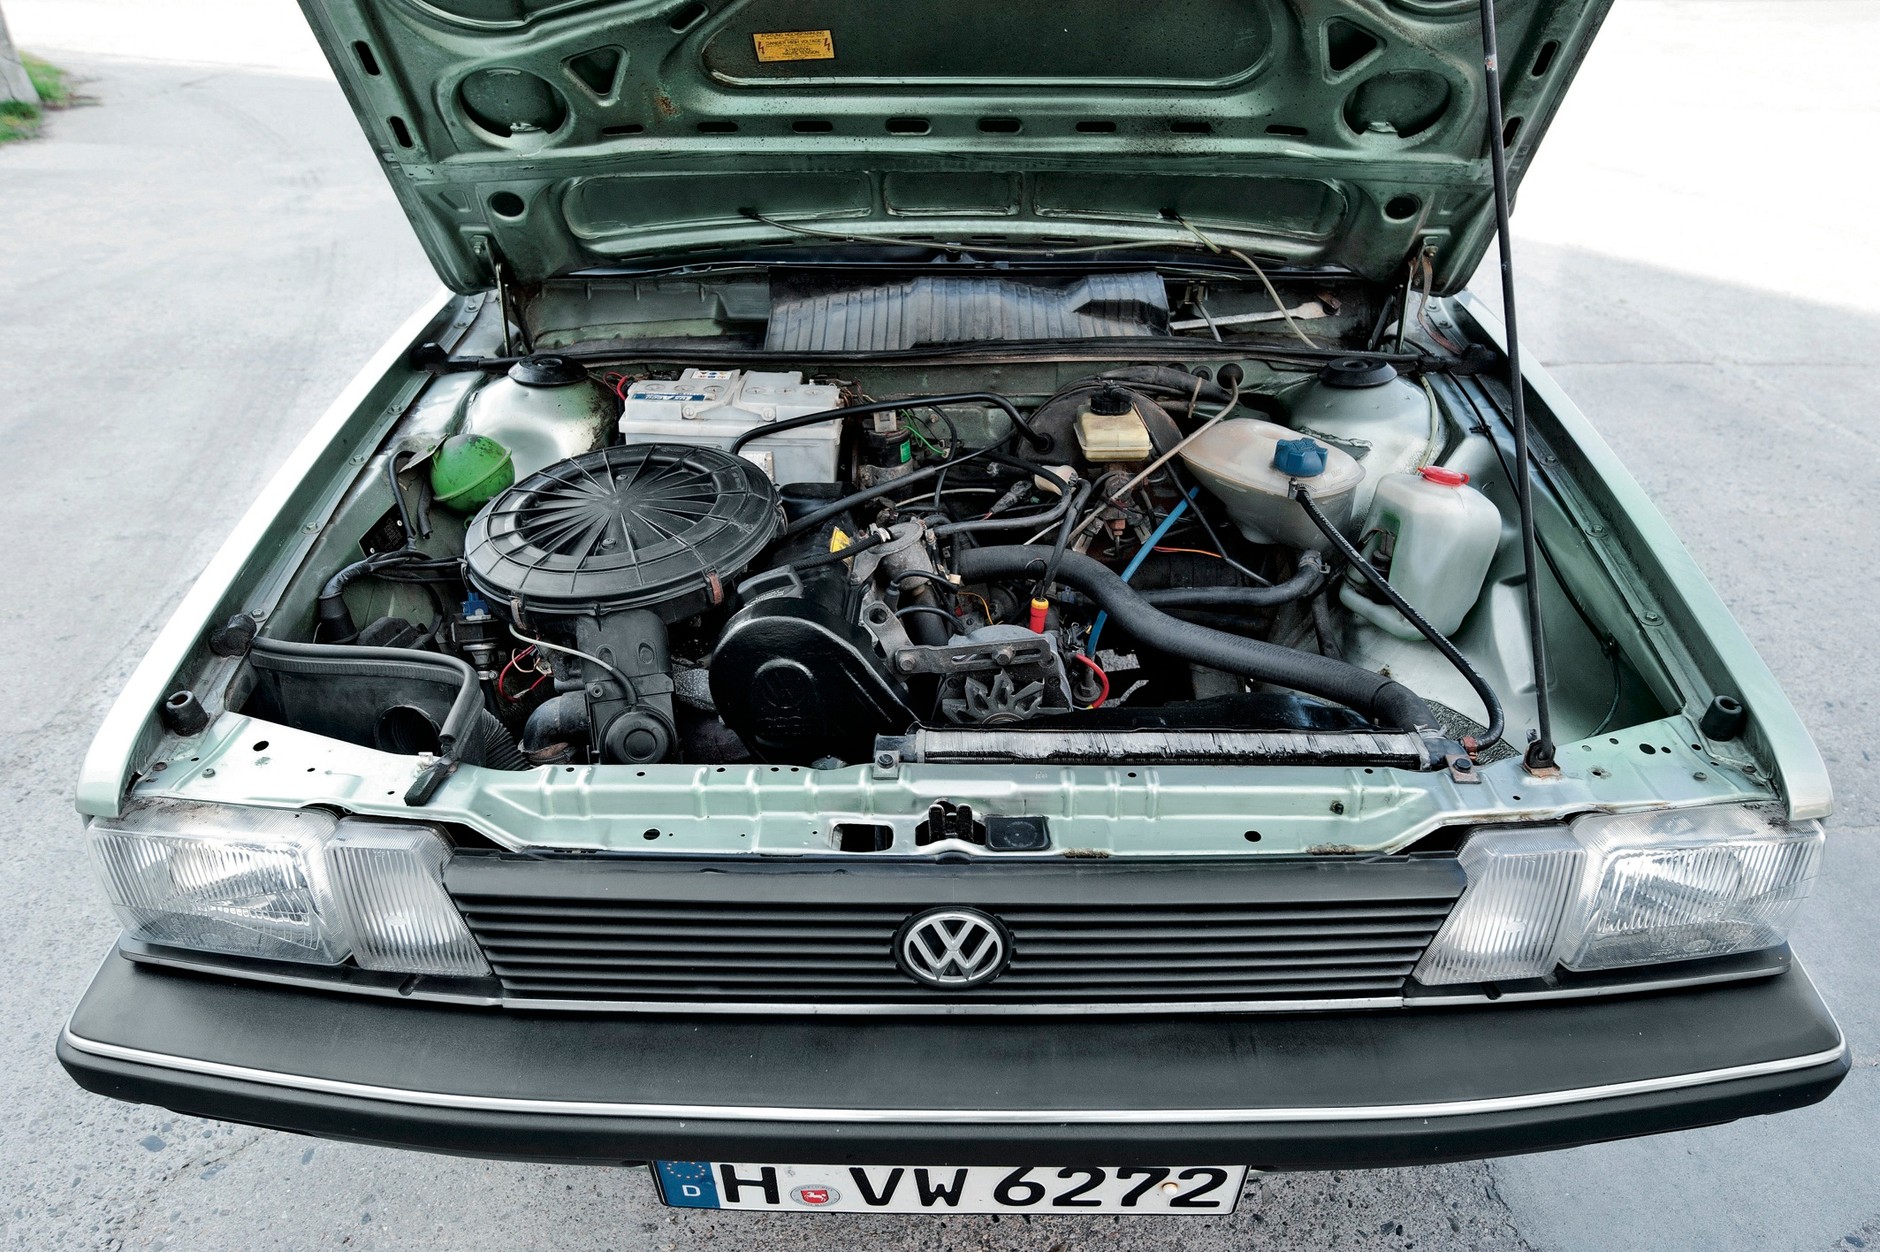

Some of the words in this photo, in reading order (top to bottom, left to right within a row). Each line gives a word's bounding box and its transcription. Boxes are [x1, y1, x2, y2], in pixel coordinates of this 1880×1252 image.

[904, 910, 1003, 983] VW
[682, 1185, 701, 1197] D
[719, 1164, 781, 1205] H
[848, 1167, 969, 1207] VW
[993, 1166, 1228, 1208] 6272
